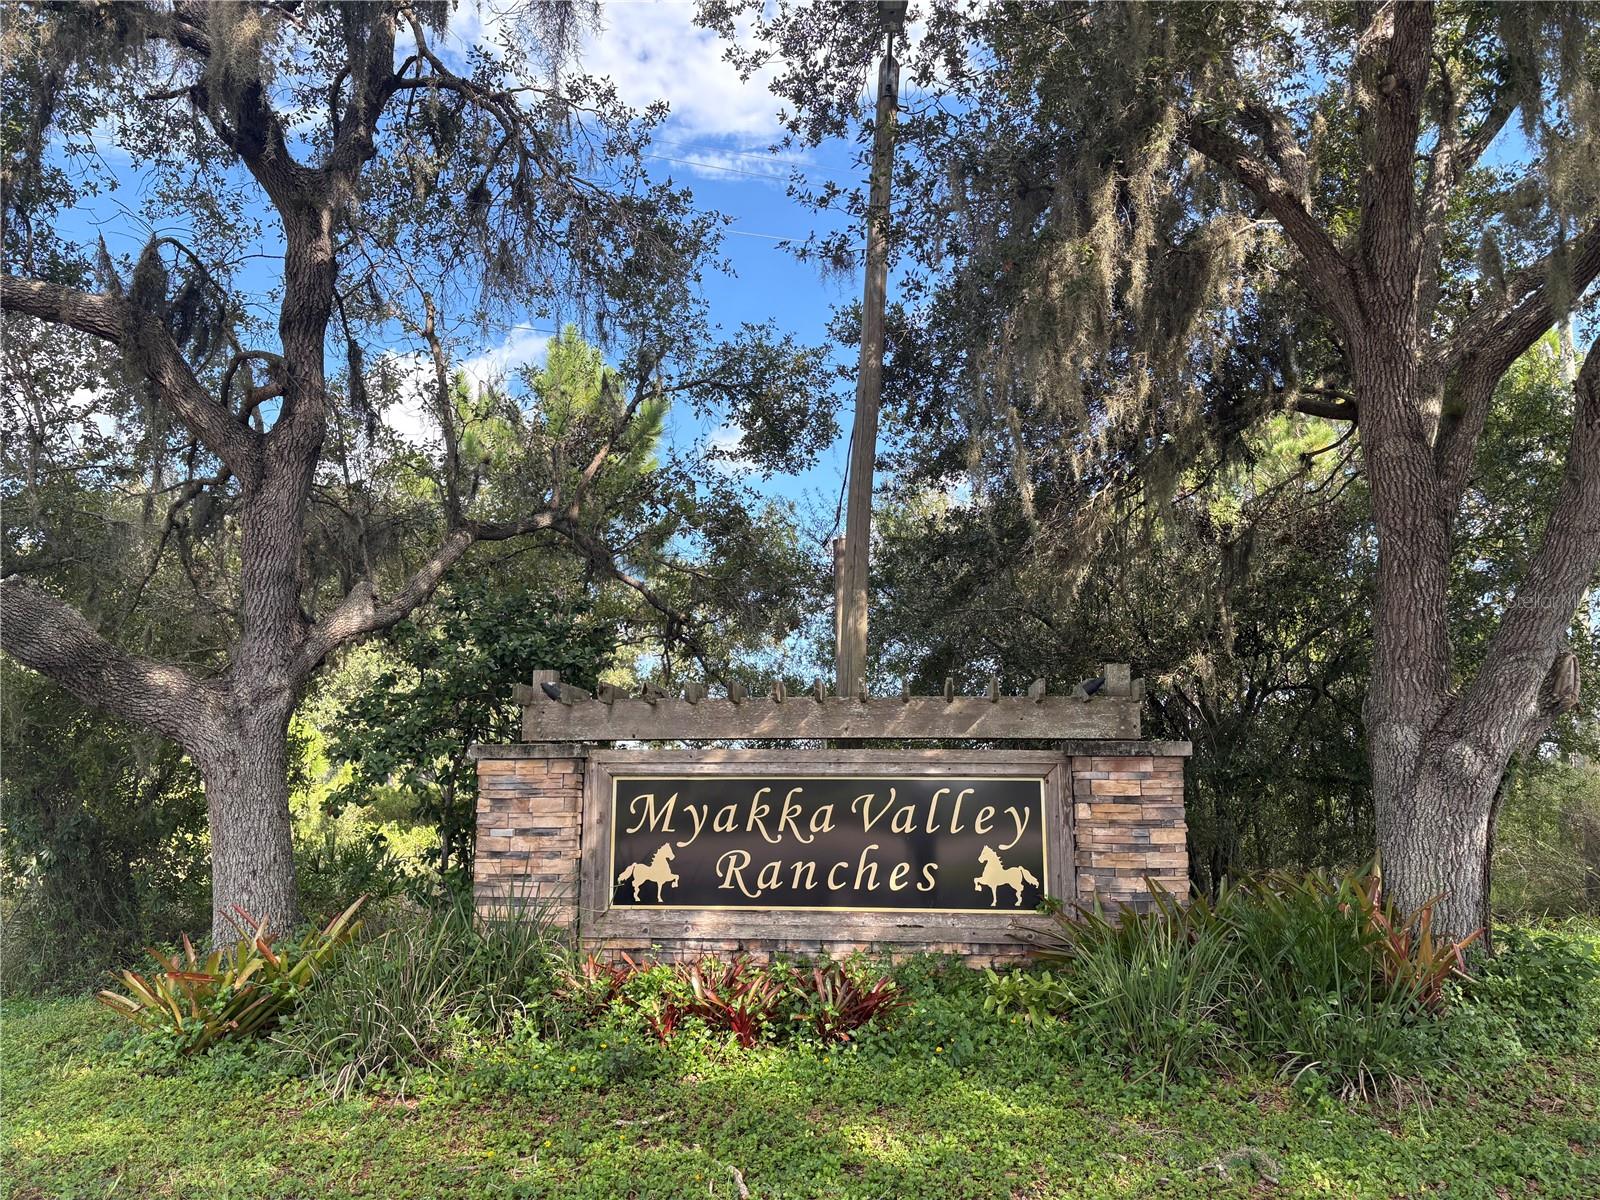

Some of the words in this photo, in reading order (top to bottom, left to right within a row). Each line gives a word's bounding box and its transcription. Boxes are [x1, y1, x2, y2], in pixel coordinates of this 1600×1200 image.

[626, 786, 836, 848] Myakka
[850, 787, 1031, 851] Valley
[716, 844, 939, 898] Ranches
